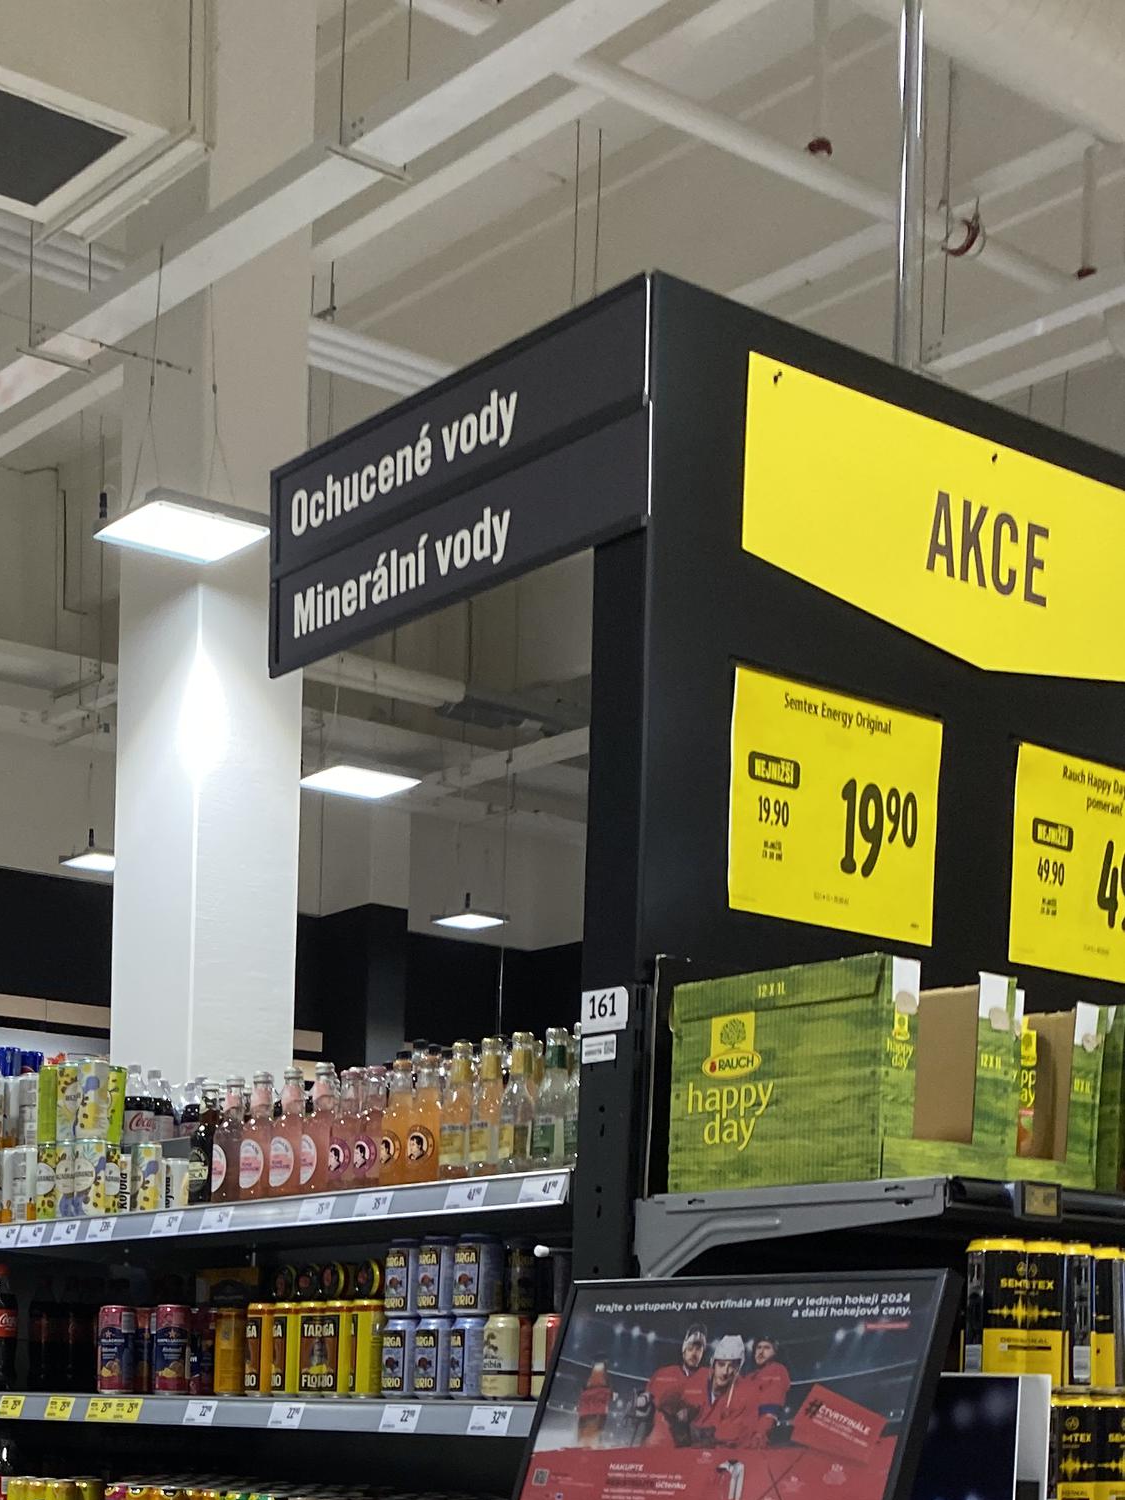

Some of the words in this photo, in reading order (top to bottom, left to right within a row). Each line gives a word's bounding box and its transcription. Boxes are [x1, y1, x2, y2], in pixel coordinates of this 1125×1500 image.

[290, 433, 432, 537] Ochucené
[441, 386, 518, 462] vody
[926, 490, 1050, 608] AKCE
[292, 532, 429, 640] Minerální
[436, 506, 512, 580] vody
[784, 692, 819, 716] Semtex
[821, 702, 854, 730] Energy
[856, 712, 892, 736] Original
[1063, 765, 1086, 784] Rauch
[1087, 772, 1112, 795] Happy
[758, 795, 790, 828] 19.90
[1037, 856, 1065, 887] 49.90
[589, 994, 617, 1020] 161
[717, 1054, 755, 1072] RAUCH
[886, 1038, 914, 1058] happy
[891, 1052, 911, 1071] day
[687, 1080, 774, 1121] happy
[1020, 1086, 1036, 1107] ay
[703, 1114, 757, 1151] day
[595, 1303, 623, 1314] Hrajte
[634, 1301, 683, 1312] vstupenky
[700, 1298, 752, 1310] čtvrtfinále
[754, 1298, 771, 1308] MS
[880, 1293, 911, 1304] 2024
[802, 1307, 827, 1318] další
[830, 1306, 879, 1318] hokejové
